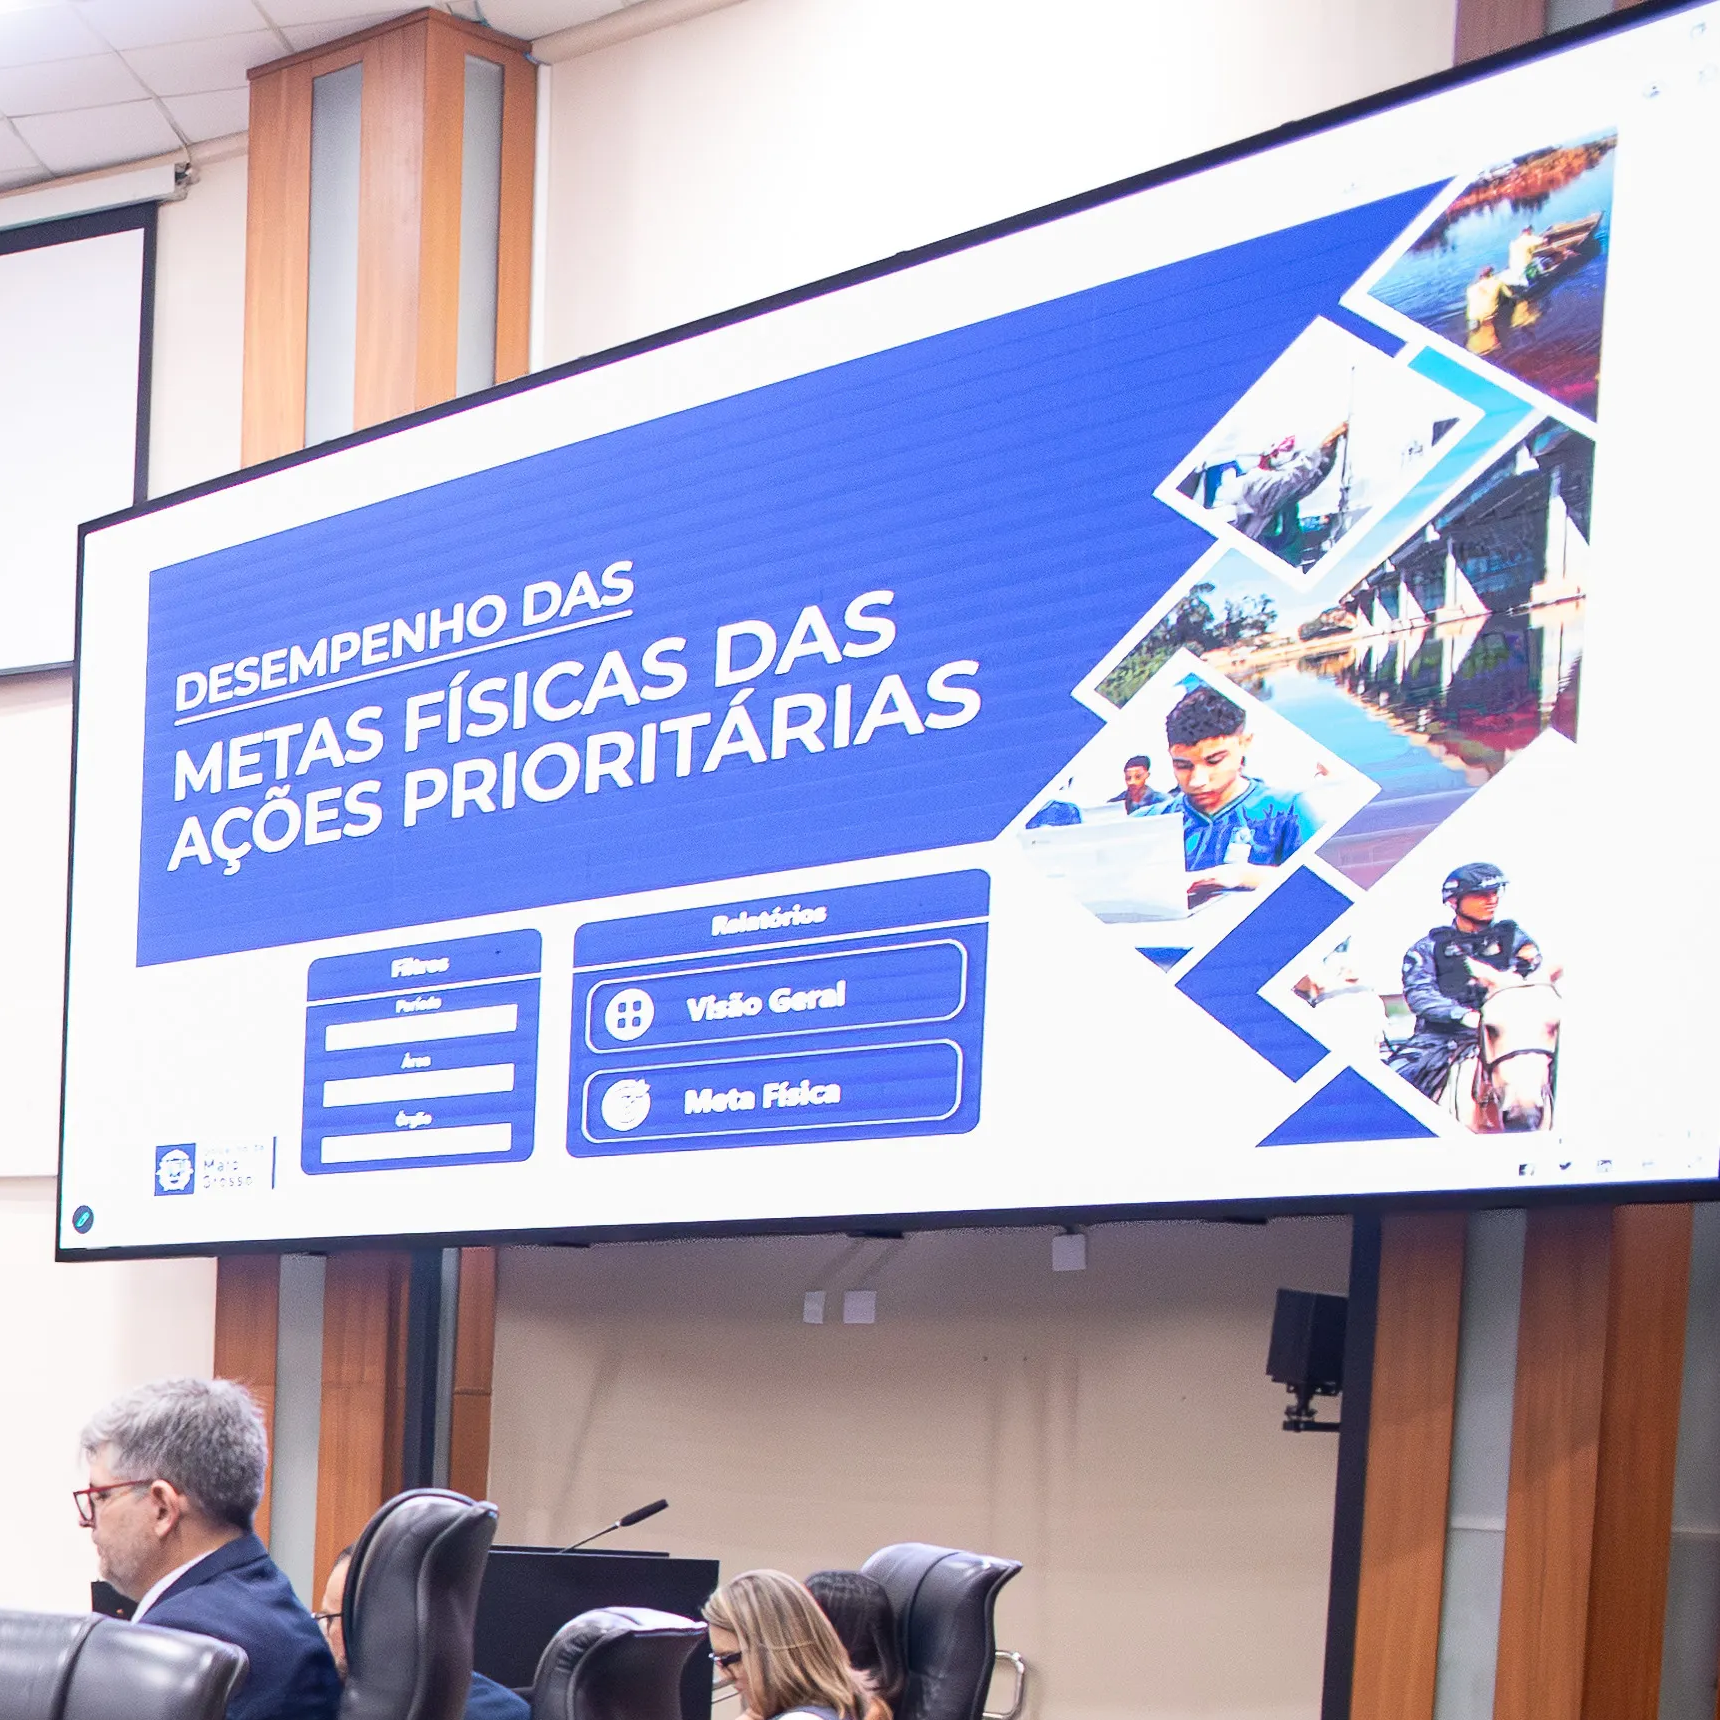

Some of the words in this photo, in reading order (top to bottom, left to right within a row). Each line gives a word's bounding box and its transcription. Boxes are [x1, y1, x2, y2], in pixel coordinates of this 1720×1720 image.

[176, 595, 508, 711] DESEMPENHO
[523, 561, 633, 626] DAS
[174, 706, 383, 801] METAS
[405, 637, 687, 752] FÍSICAS
[716, 590, 895, 687] DAS
[168, 780, 382, 876] AÇÕES
[405, 660, 980, 827] PRIORITÁRIAS
[712, 904, 827, 936] Relatórios
[391, 957, 450, 978] Filtros
[687, 991, 762, 1021] Visão
[769, 980, 846, 1013] Geral
[684, 1089, 756, 1114] Meta
[763, 1080, 841, 1109] Física
